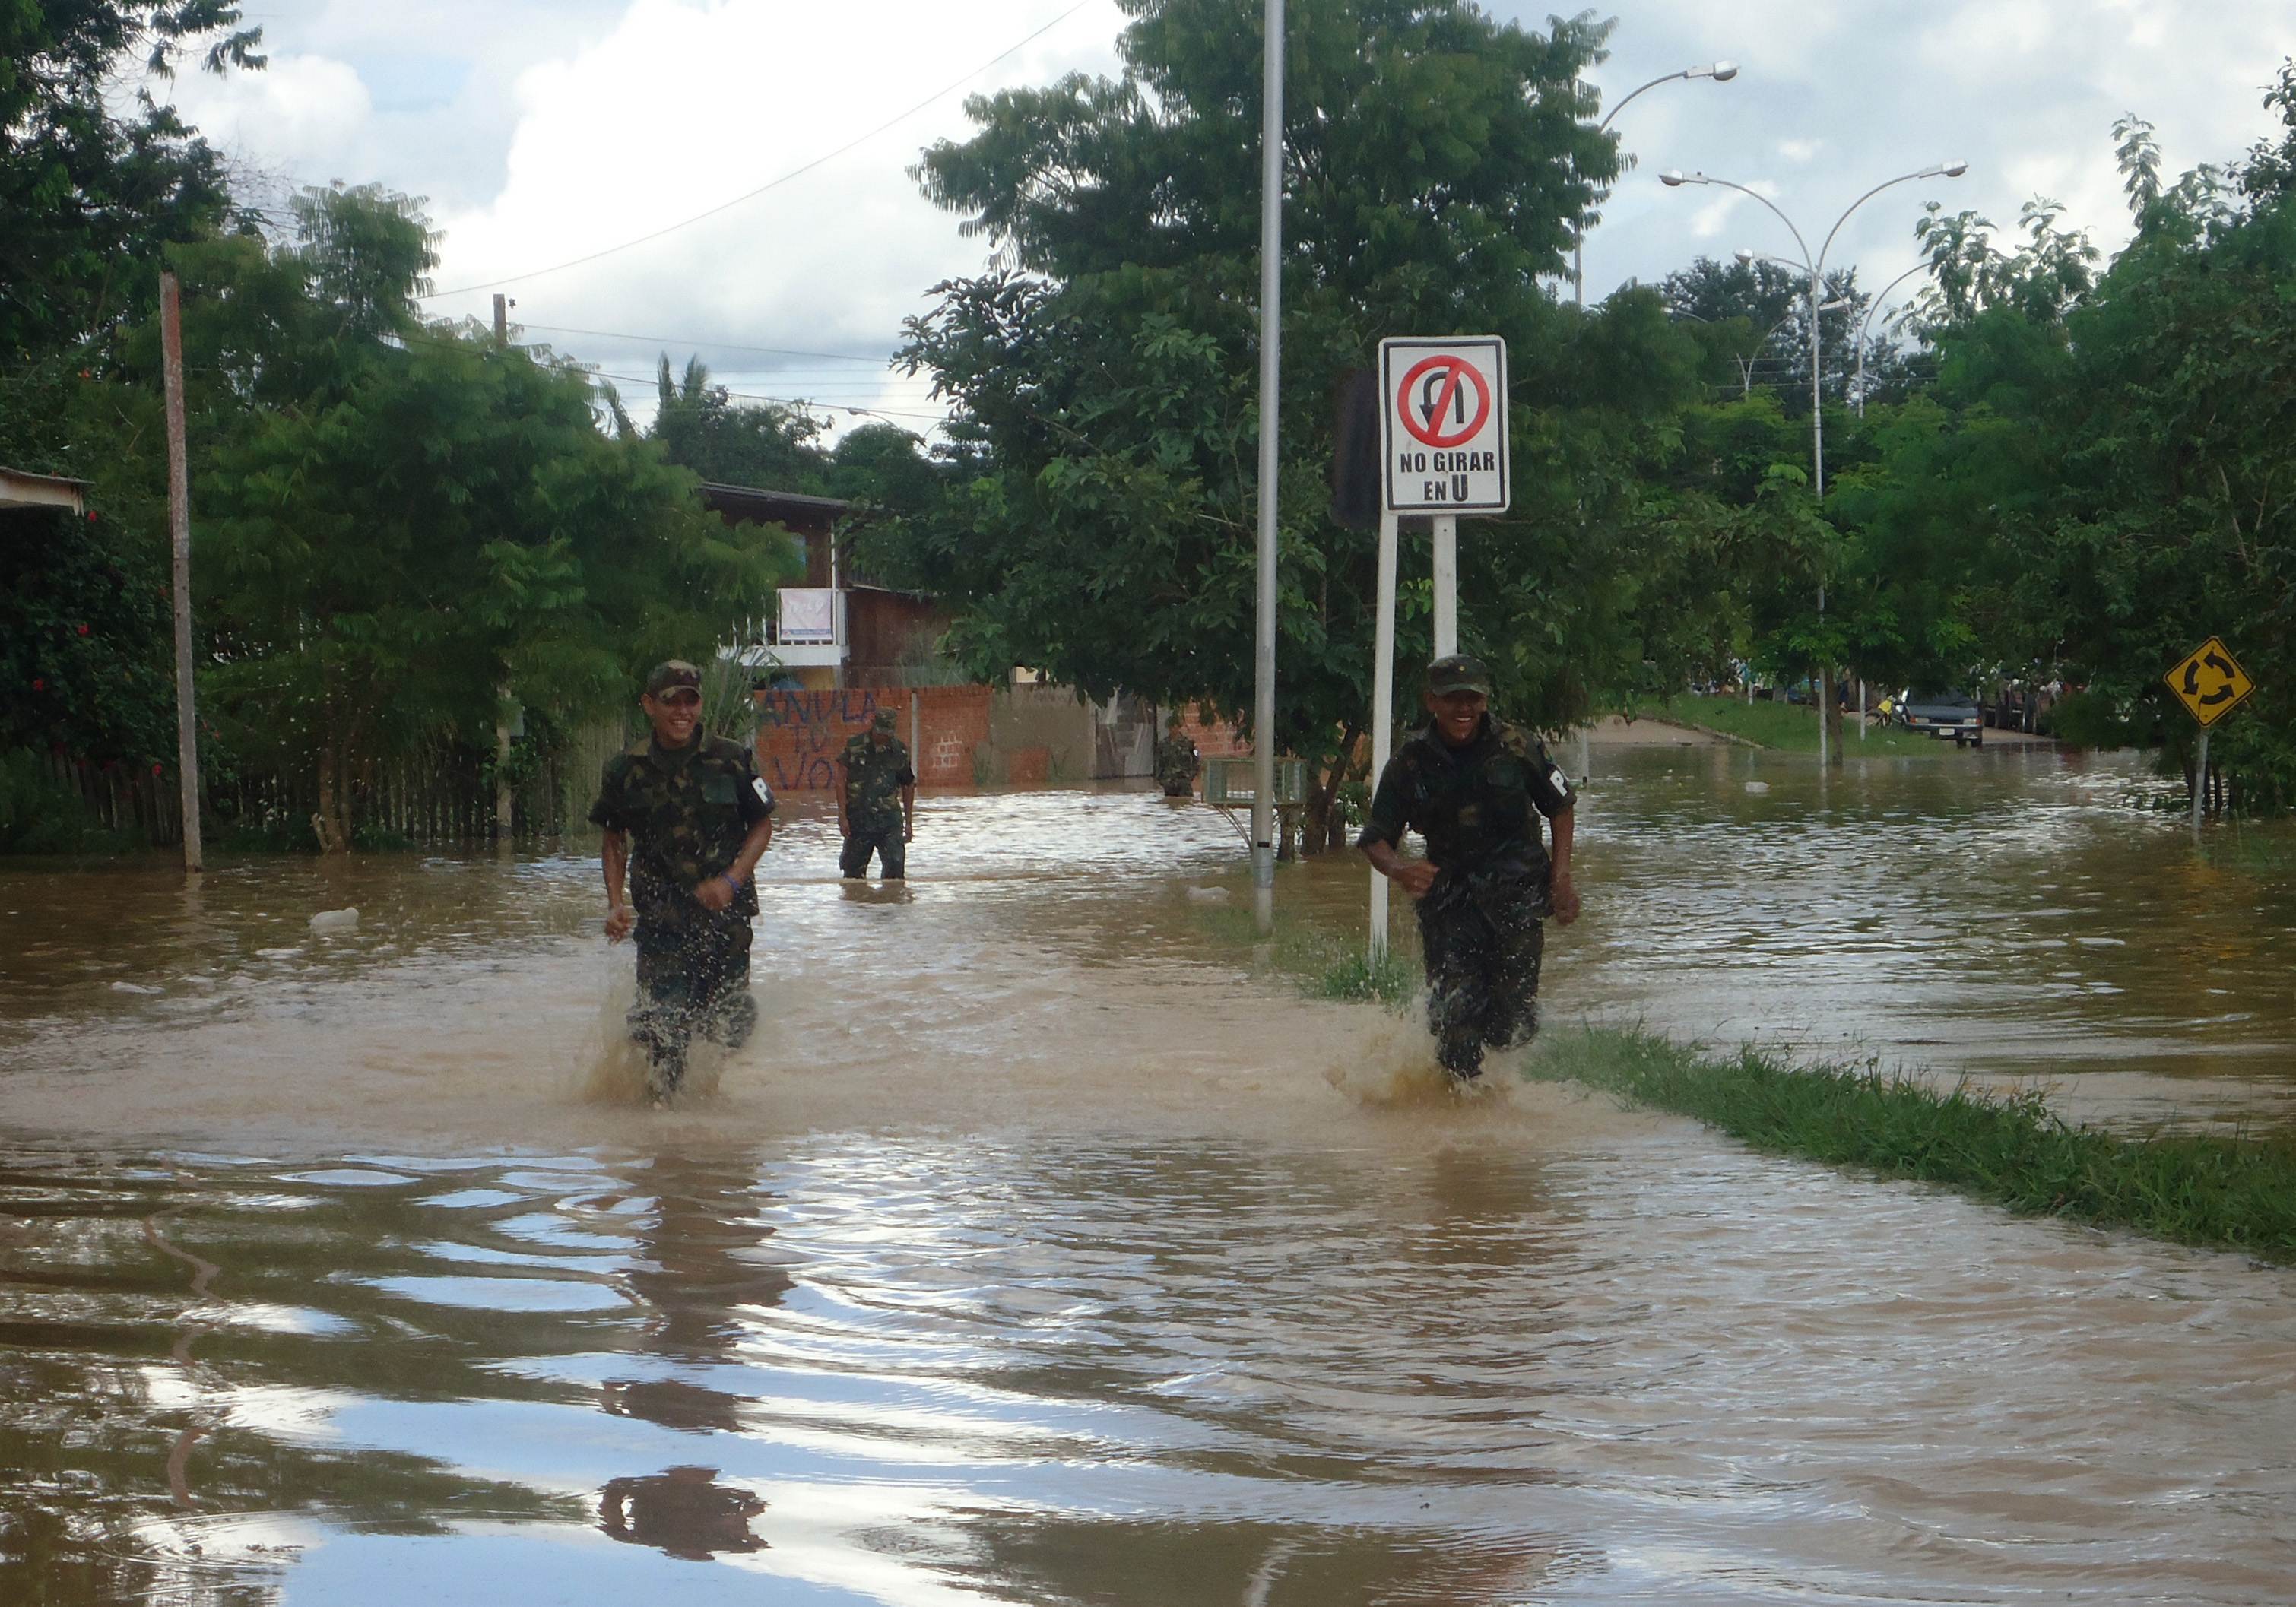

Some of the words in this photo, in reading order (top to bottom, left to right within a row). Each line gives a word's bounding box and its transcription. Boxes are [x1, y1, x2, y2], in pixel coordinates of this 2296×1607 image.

[1400, 452, 1426, 473] NO
[1433, 451, 1495, 471] GIRAR
[1424, 481, 1446, 500] EN
[1452, 474, 1468, 502] U
[1549, 770, 1568, 797] P
